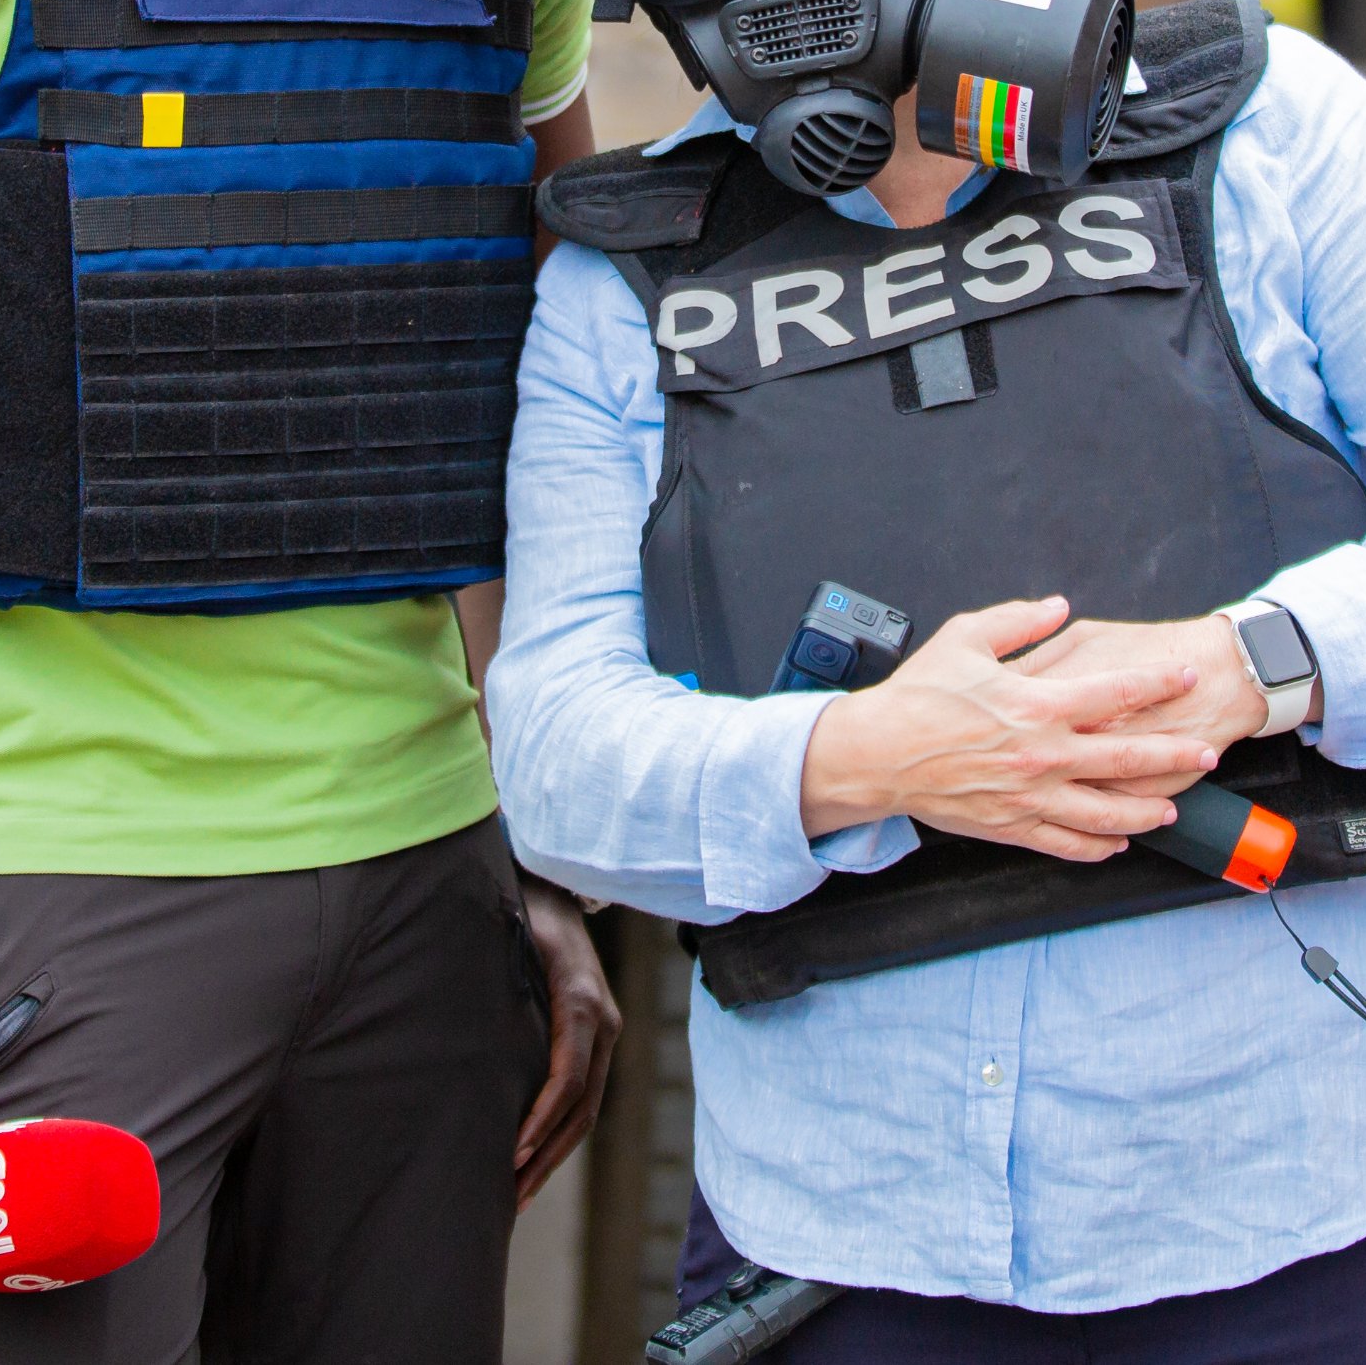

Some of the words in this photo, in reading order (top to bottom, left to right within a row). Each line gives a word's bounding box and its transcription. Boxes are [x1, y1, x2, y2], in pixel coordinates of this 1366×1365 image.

[1020, 100, 1028, 113] UK
[1017, 123, 1026, 141] Made
[656, 195, 1157, 376] PRESS
[825, 592, 845, 611] 10
